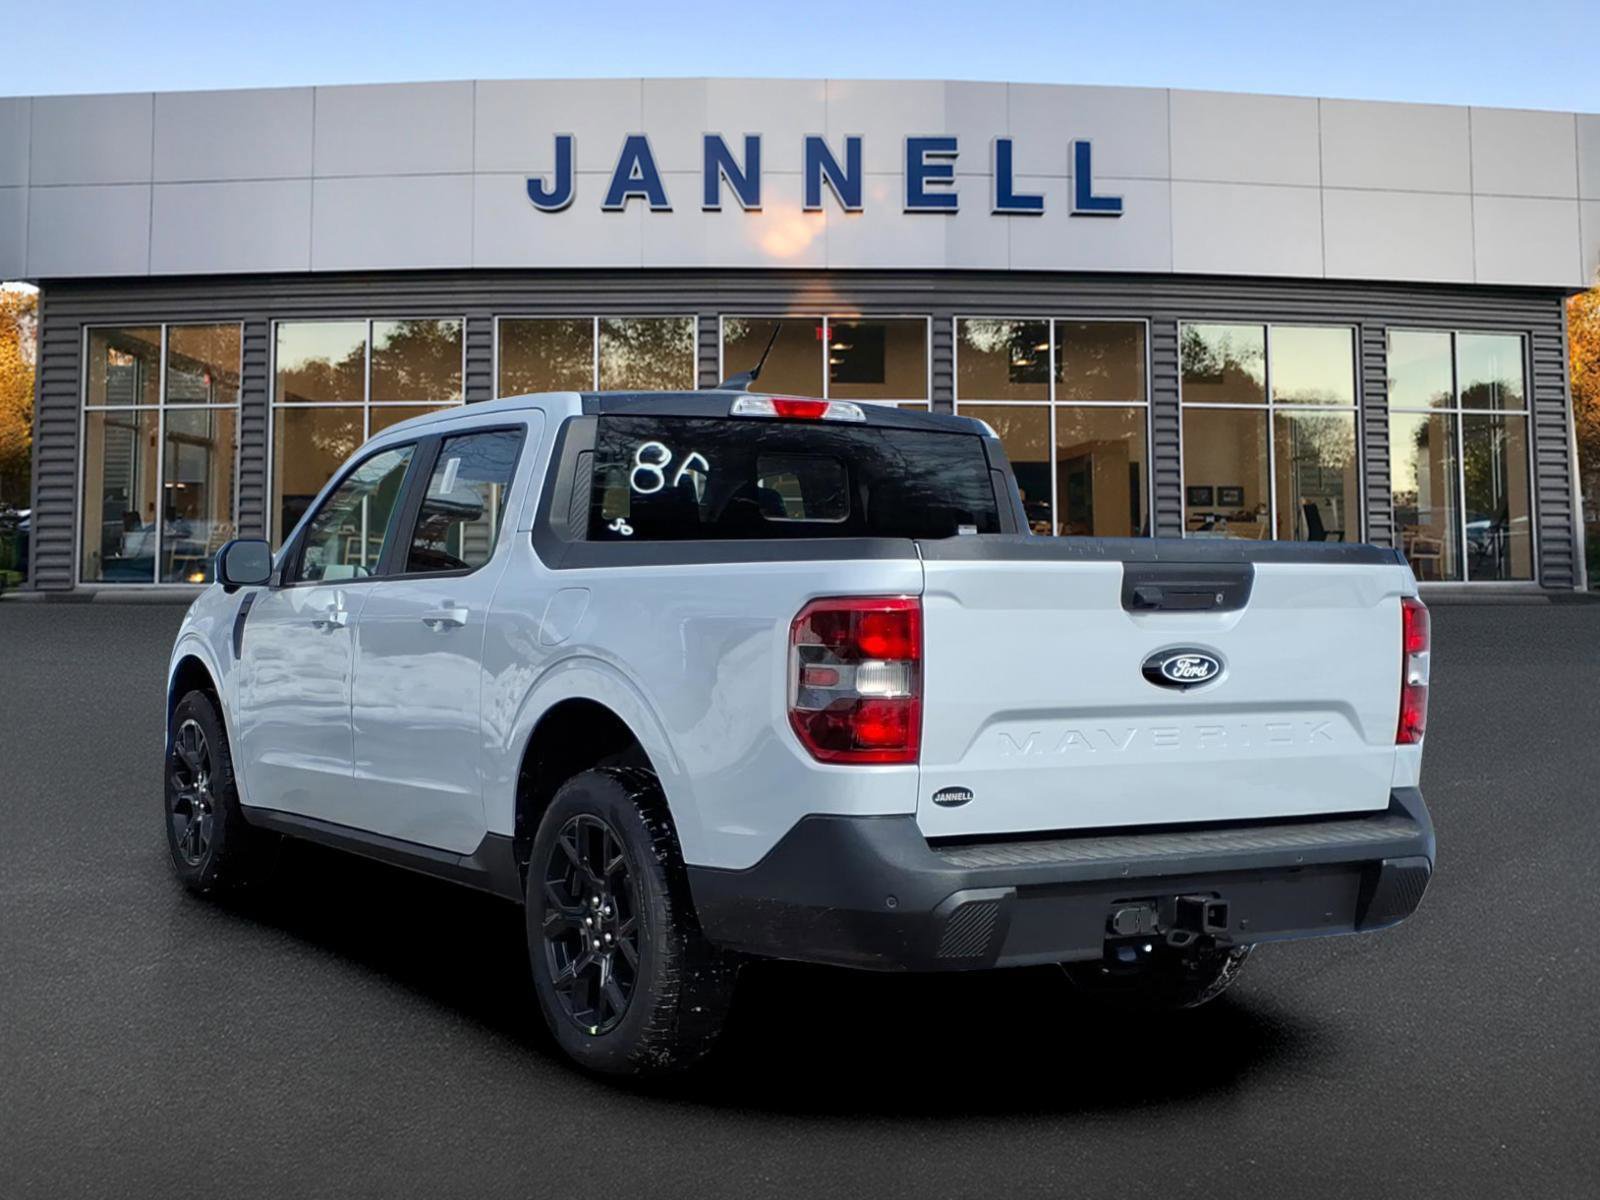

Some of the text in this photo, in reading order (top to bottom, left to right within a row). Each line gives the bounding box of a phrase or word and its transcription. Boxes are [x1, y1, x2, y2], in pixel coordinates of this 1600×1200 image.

[526, 132, 1124, 216] JANNELL
[1172, 658, 1209, 677] Ford
[998, 721, 1335, 757] MAVERICK
[934, 792, 973, 802] JANNELL
